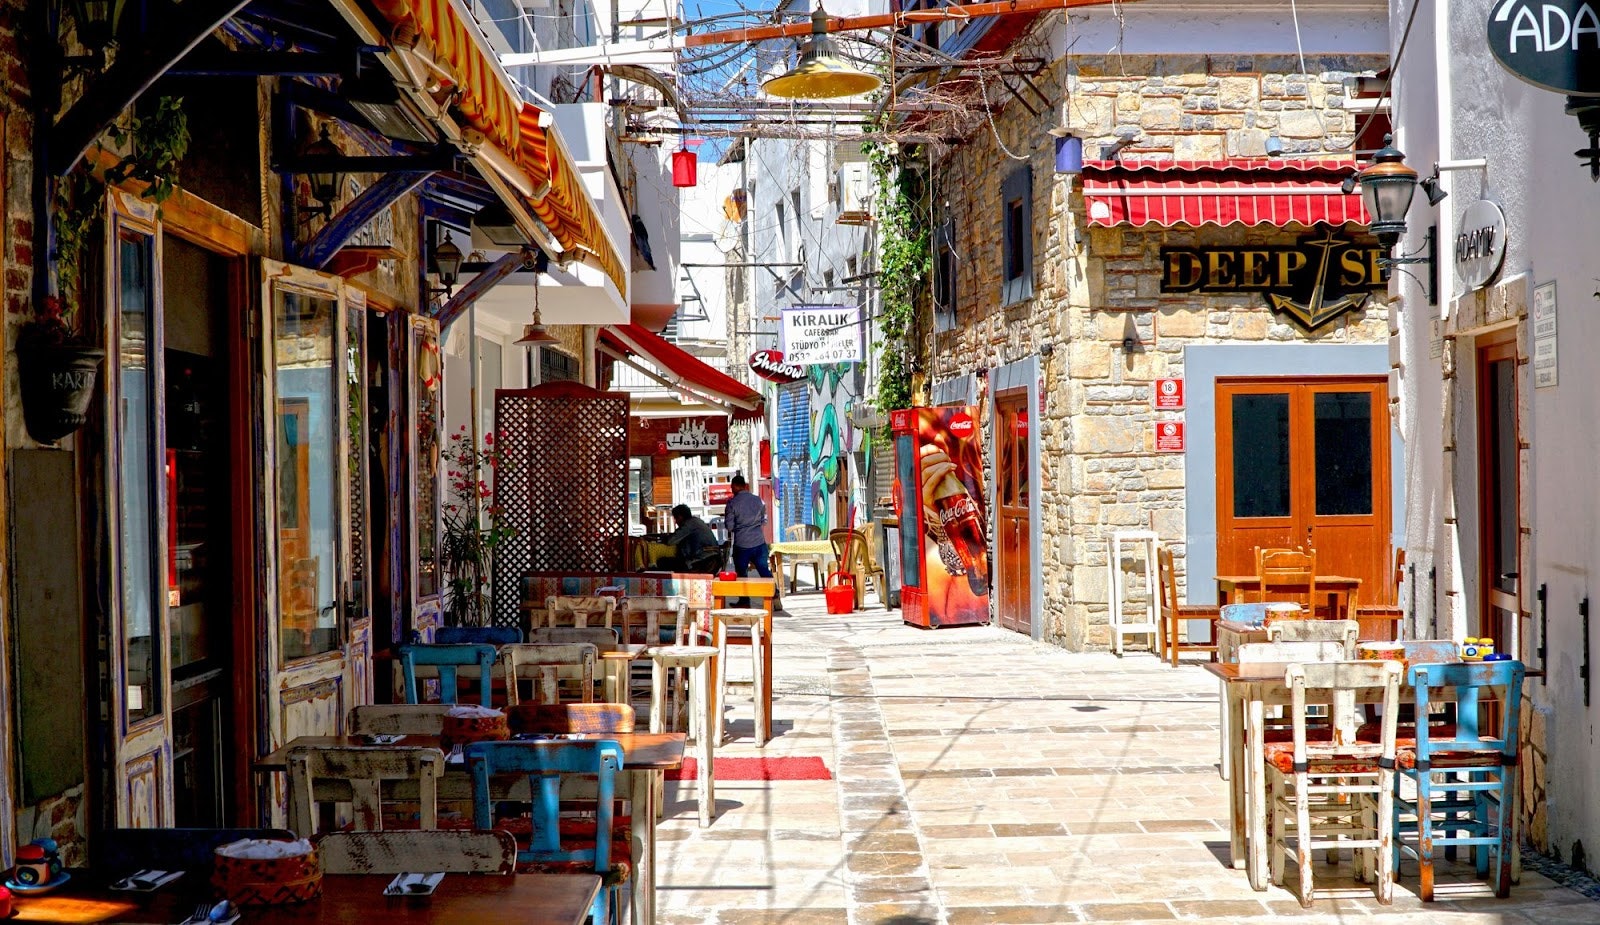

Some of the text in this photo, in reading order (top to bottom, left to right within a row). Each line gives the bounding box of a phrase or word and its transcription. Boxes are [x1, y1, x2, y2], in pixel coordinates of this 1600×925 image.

[1164, 251, 1307, 288] DEEP
[792, 312, 848, 327] KİRALIK
[804, 328, 839, 337] CAFE&AR
[791, 339, 819, 350] STÜDYO
[1164, 383, 1173, 392] 18
